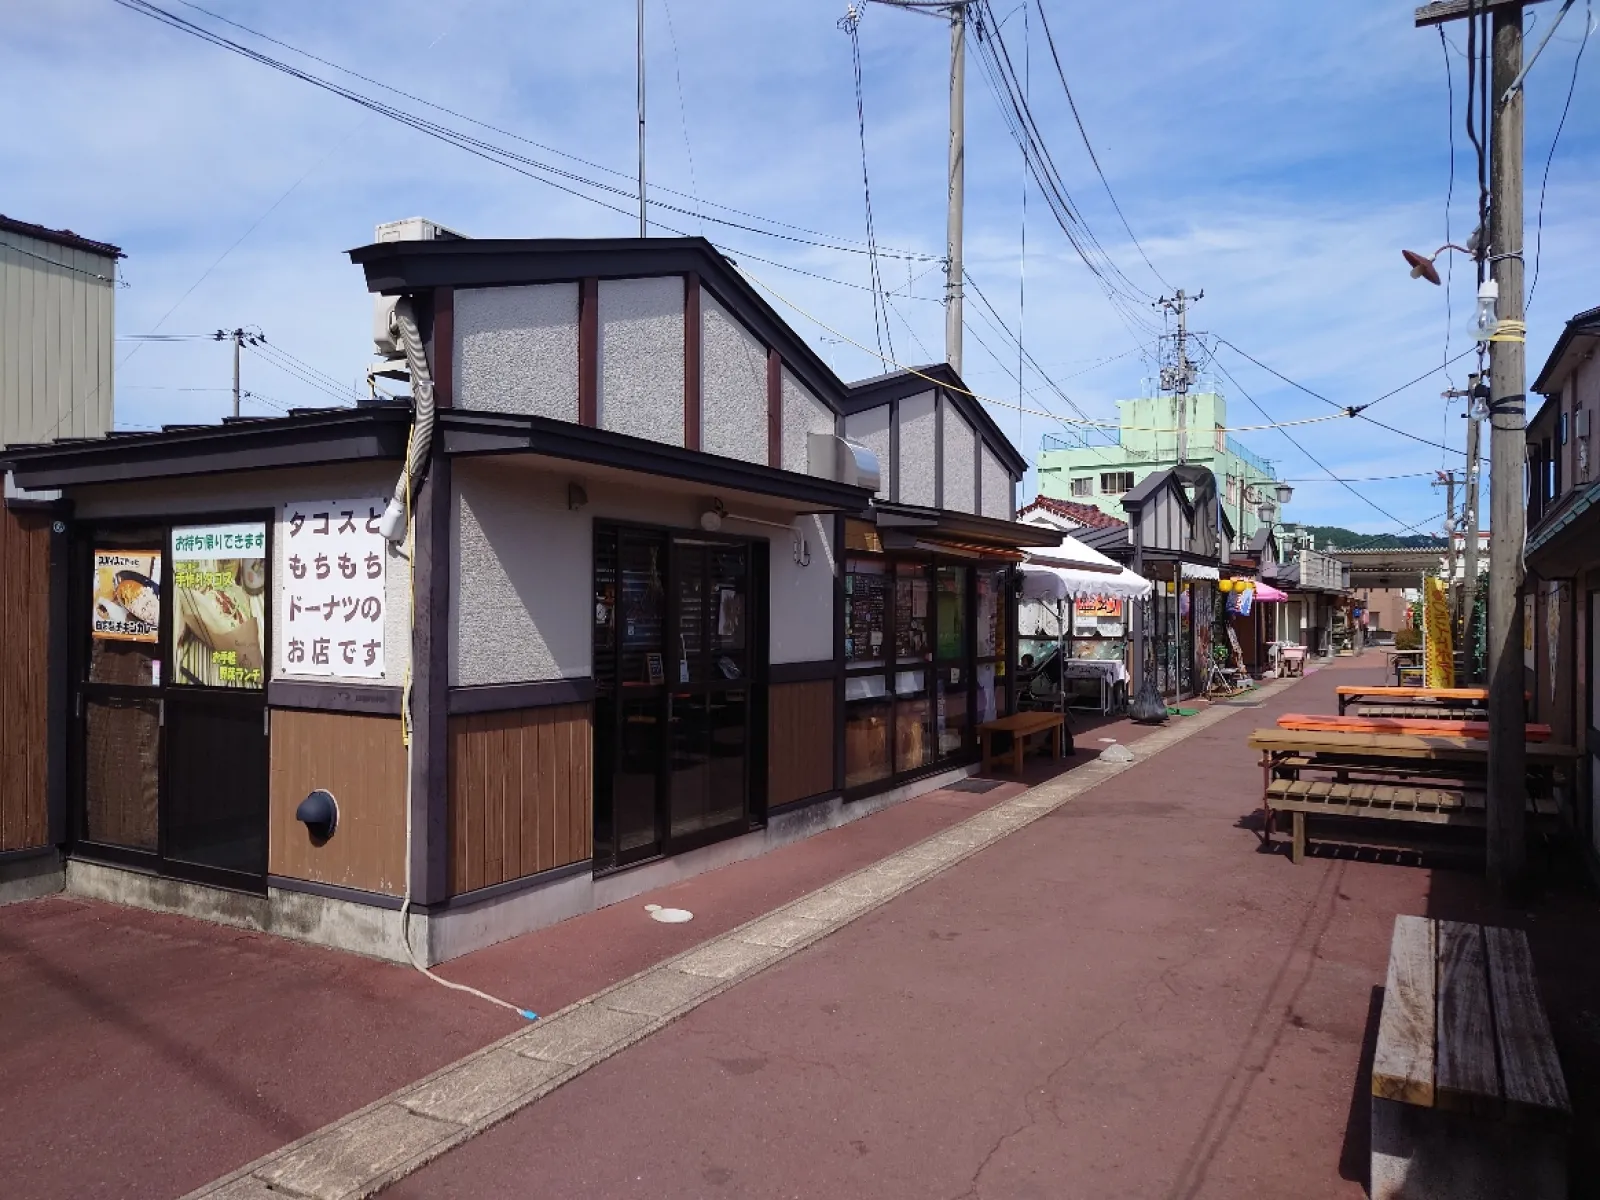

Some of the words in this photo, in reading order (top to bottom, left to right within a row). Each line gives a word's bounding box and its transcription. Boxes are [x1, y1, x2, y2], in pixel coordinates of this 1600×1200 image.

[289, 507, 382, 537] タコスと
[175, 532, 265, 552] お持ち帰りできます
[288, 551, 382, 580] もちもち
[289, 595, 382, 622] ドーナツの
[288, 637, 382, 667] お店です
